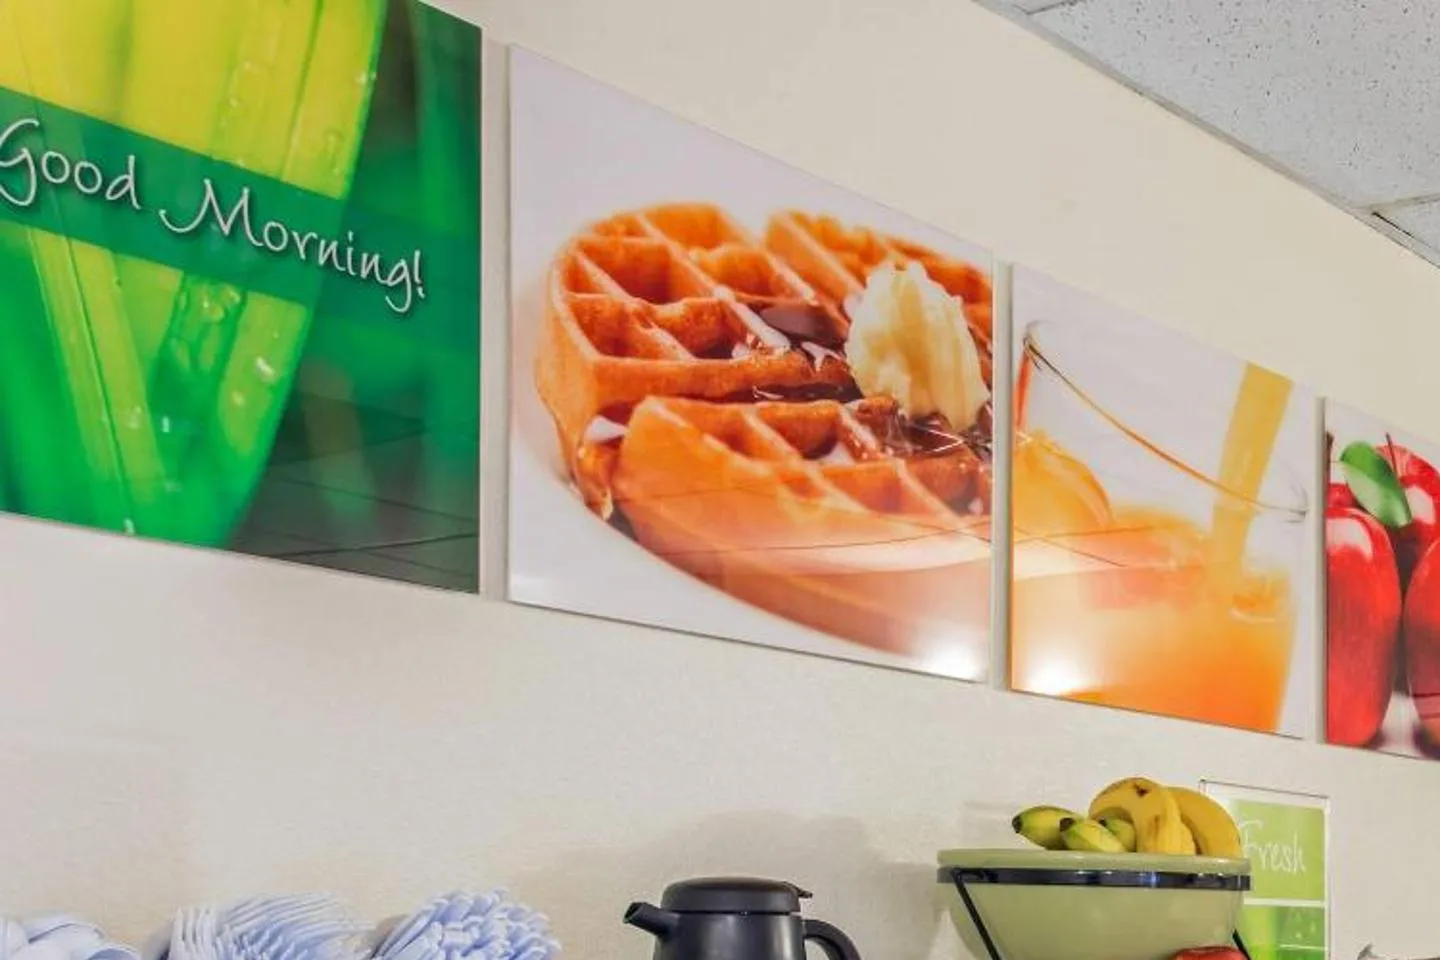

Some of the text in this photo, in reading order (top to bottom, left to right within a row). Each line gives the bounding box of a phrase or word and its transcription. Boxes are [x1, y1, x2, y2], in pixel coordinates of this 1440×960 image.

[0, 118, 425, 313] Good Morning!
[1240, 818, 1307, 875] Fresh
